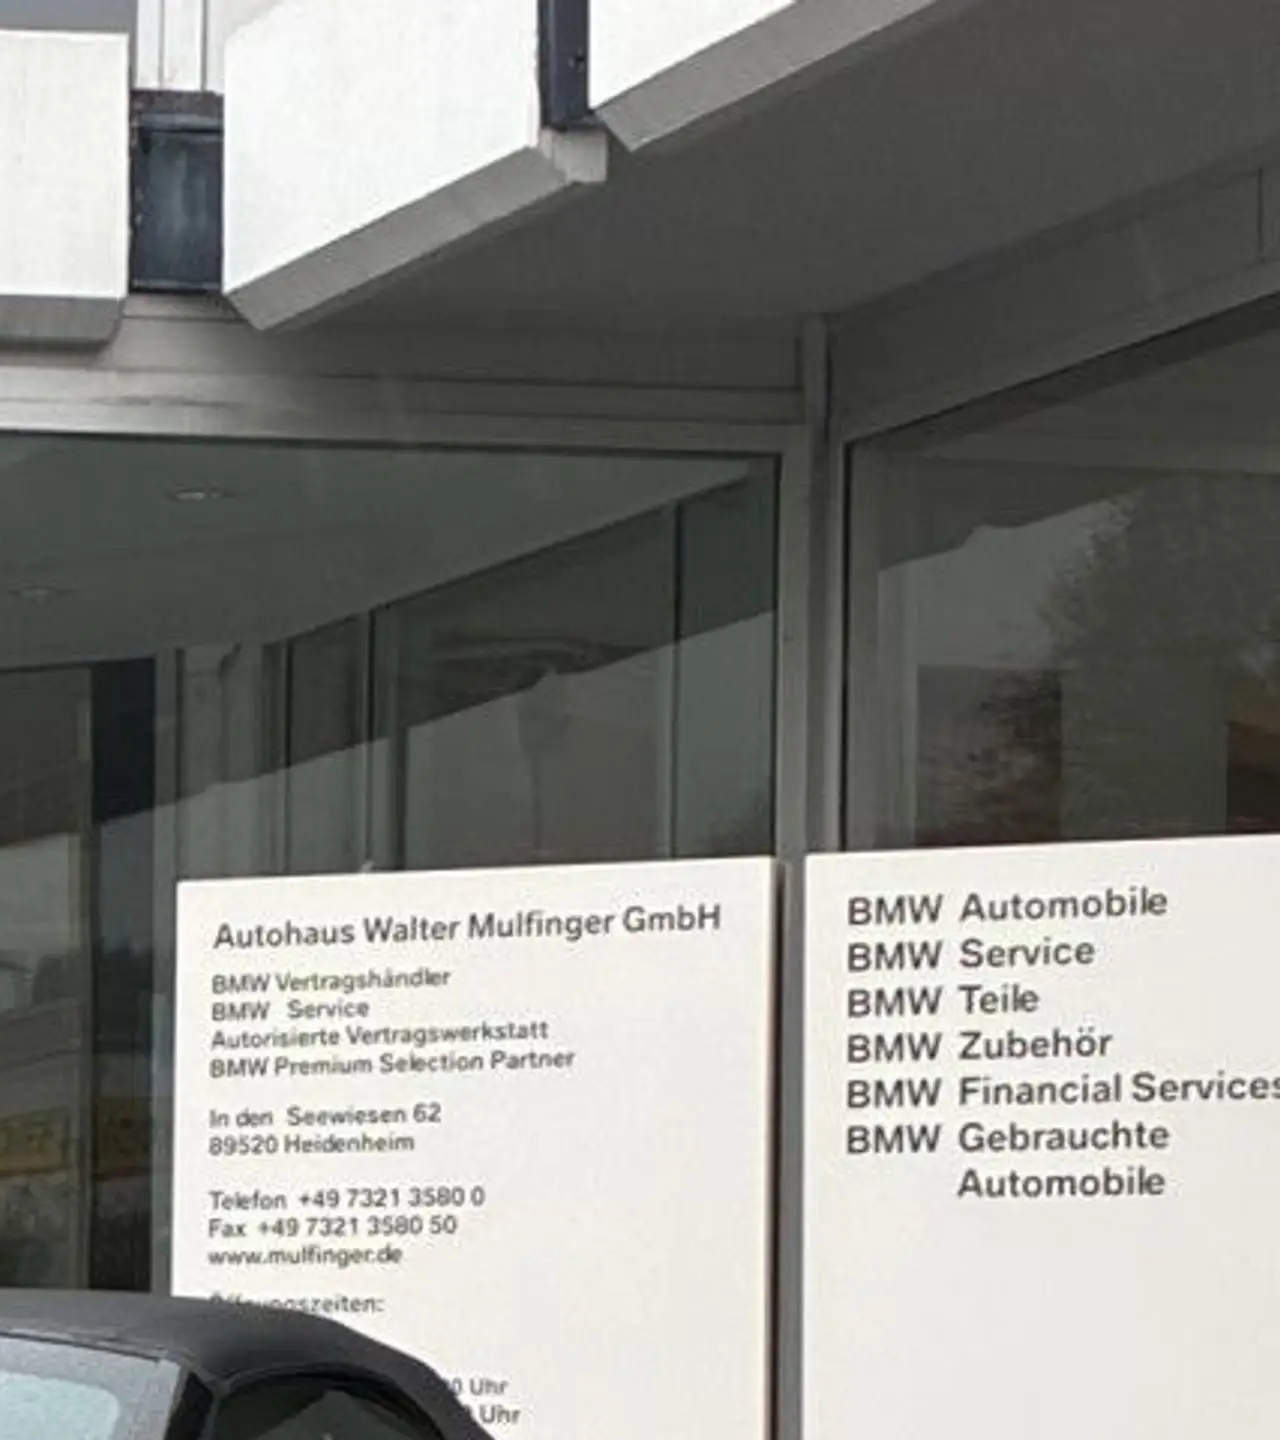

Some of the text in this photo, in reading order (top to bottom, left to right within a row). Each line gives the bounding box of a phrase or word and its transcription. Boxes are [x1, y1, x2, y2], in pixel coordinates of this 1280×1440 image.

[847, 885, 1168, 926] BMW Automobile
[212, 903, 721, 949] Autohaus Walter Mulfinger GmbH
[847, 936, 1096, 973] BMW Service
[211, 973, 271, 995] BMW
[211, 998, 370, 1022] BMW Service
[847, 983, 1040, 1019] BMW Teile
[211, 1020, 549, 1050] Autorisierte Vertragswerkstatt
[847, 1026, 1113, 1064] BMW Zubehör
[209, 1049, 576, 1079] BMW Premium Selection Partner
[846, 1077, 942, 1109] BMW
[959, 1072, 1122, 1106] Financial
[209, 1101, 442, 1129] In den Seewiesen 62
[208, 1132, 415, 1157] 89520 Heidenheim
[846, 1119, 1170, 1155] BMW Gebrauchte
[956, 1165, 1166, 1199] Automobile
[207, 1184, 486, 1211] Telefon +49 7321 3580 0
[208, 1213, 459, 1238] Fax +49 7321 3580 50
[207, 1243, 403, 1269] www.mulfinger.de
[469, 1377, 509, 1396] Uhr
[479, 1404, 521, 1424] Uhr
